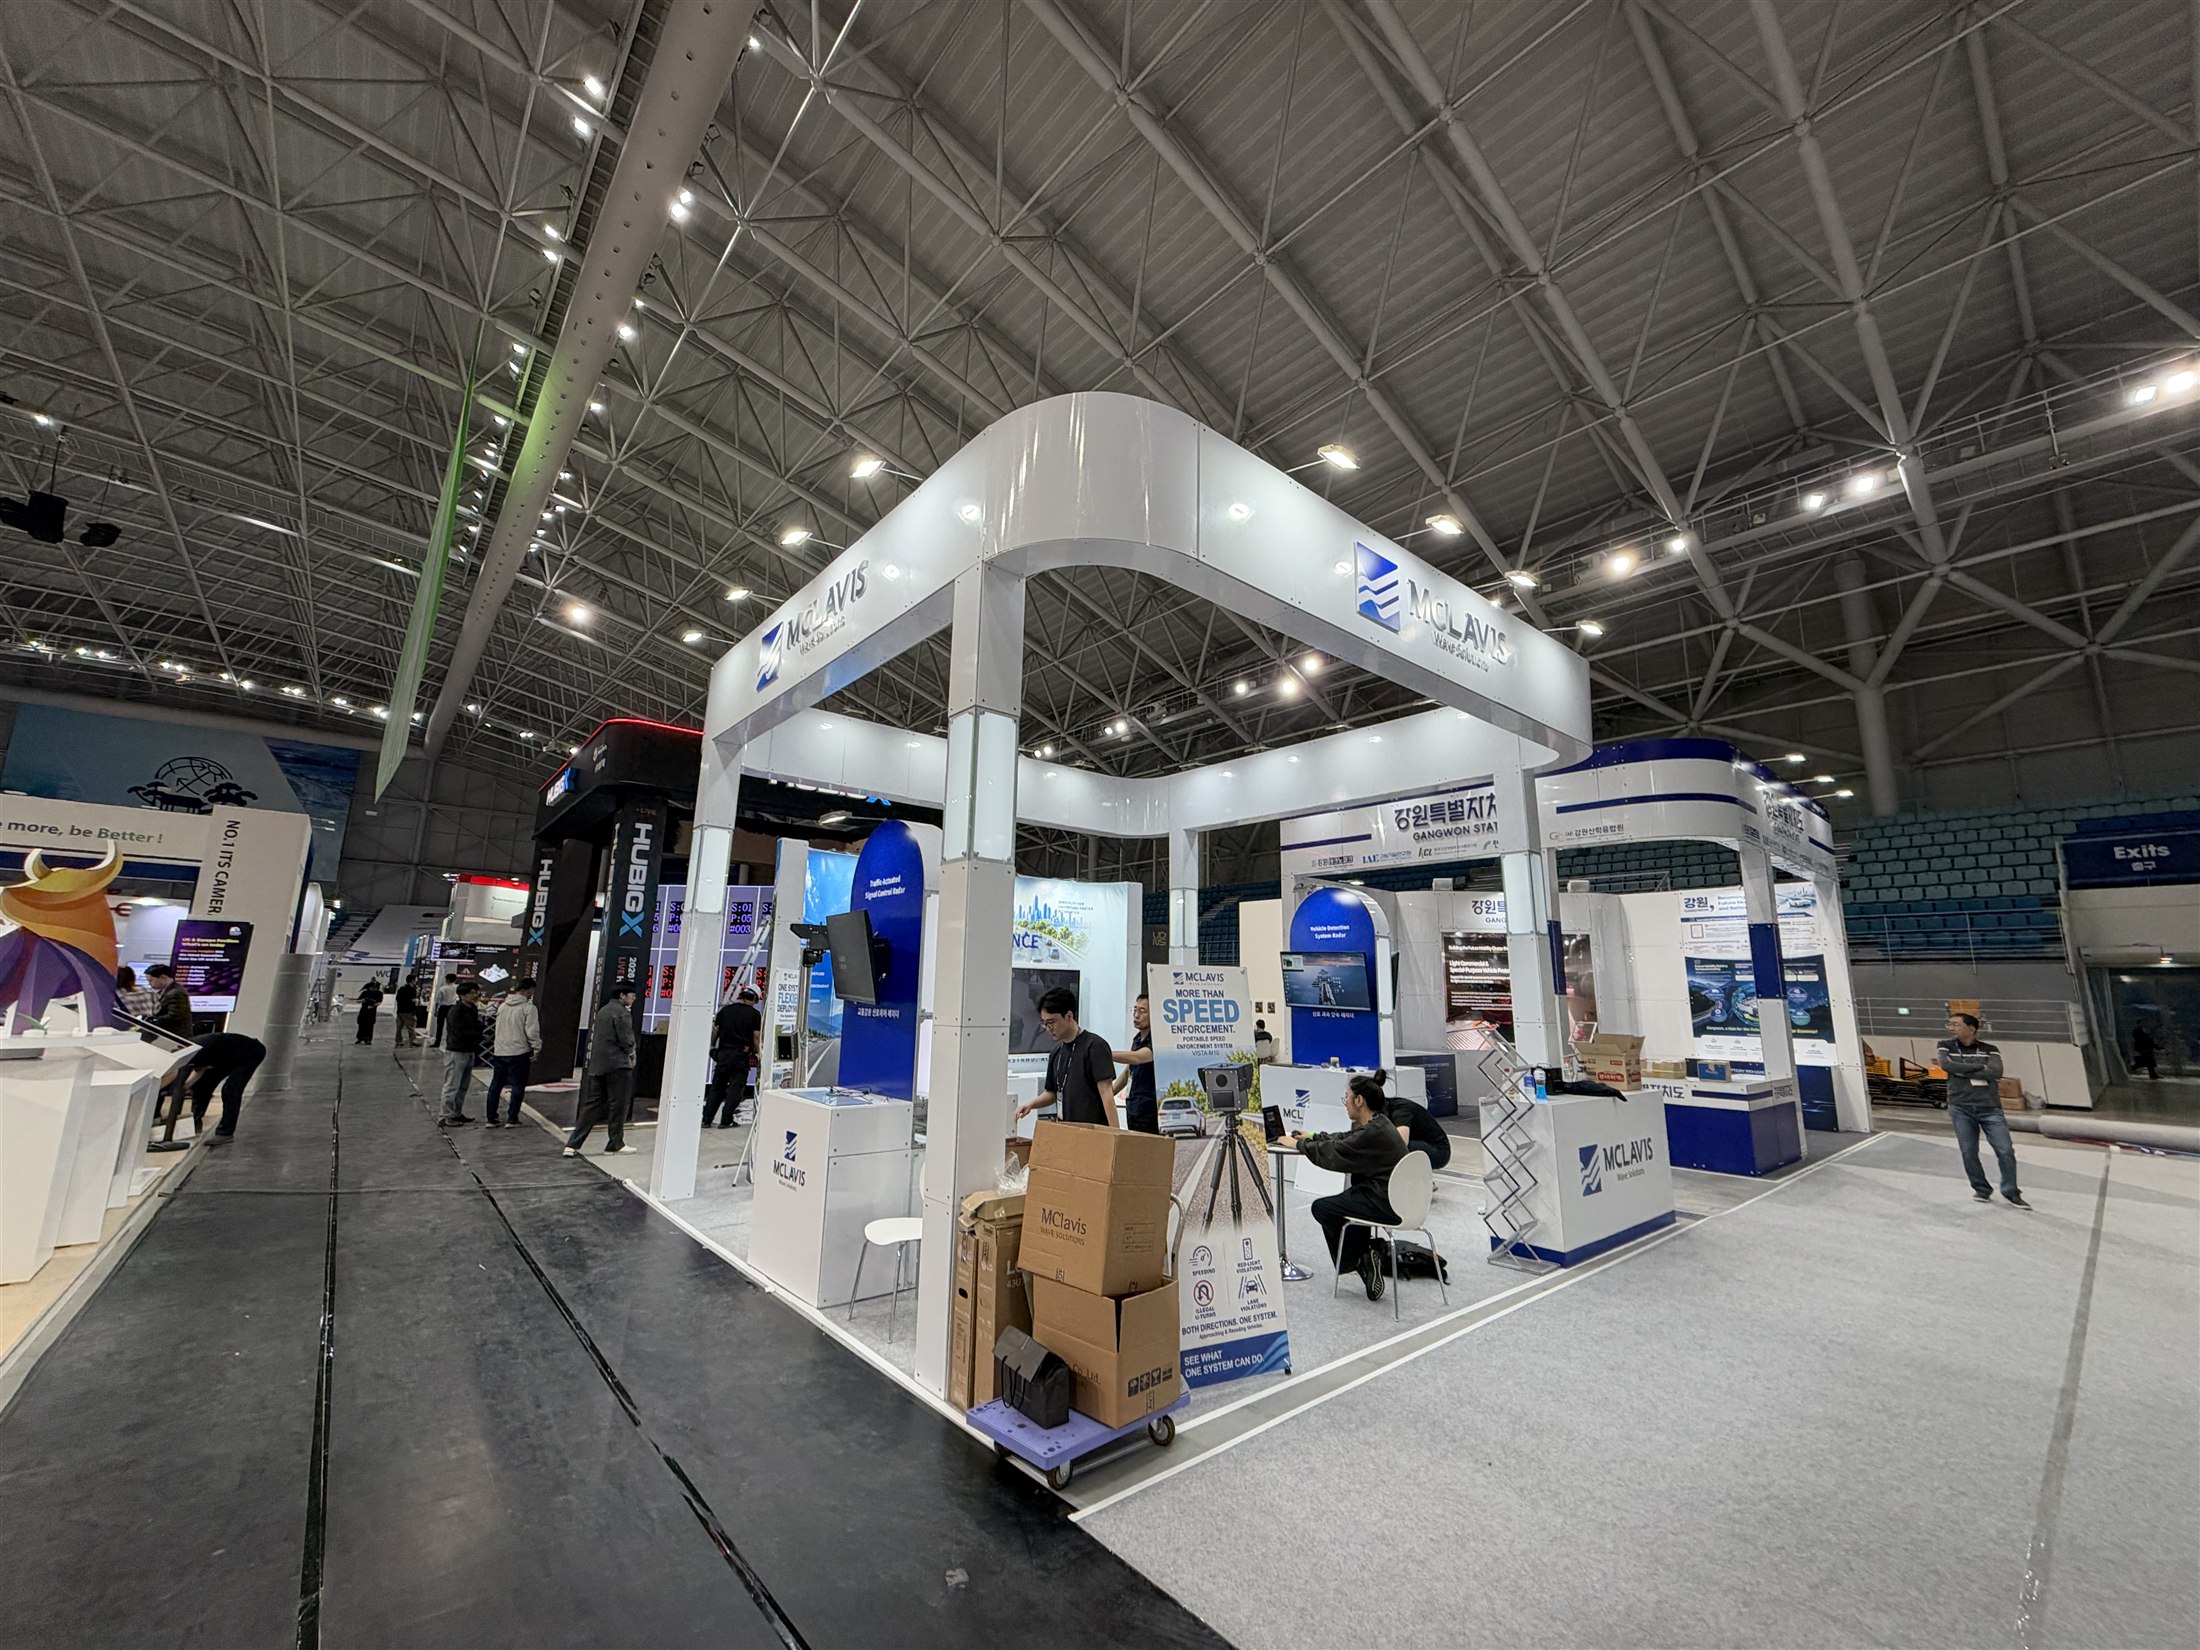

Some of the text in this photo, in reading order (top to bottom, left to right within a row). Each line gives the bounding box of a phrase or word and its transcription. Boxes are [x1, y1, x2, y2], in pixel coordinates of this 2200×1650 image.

[786, 559, 869, 651] MCLAVIS
[1407, 578, 1511, 666] MCLAVIS
[1432, 631, 1456, 656] Wave
[7, 821, 63, 837] more,
[69, 824, 93, 838] be
[97, 827, 155, 843] Better
[1413, 825, 1471, 841] GANGWON
[2113, 844, 2171, 860] Exits
[207, 820, 240, 915] NO.1 ITS CAMER
[619, 822, 653, 938] HUBIGX
[527, 858, 553, 947] HUBIGX
[731, 903, 753, 912] S:01
[730, 914, 752, 923] P:05
[729, 924, 751, 933] #003
[628, 956, 637, 978] 2026
[1185, 972, 1225, 983] MCLAVIS
[1175, 989, 1224, 998] MORE THAN
[1163, 998, 1240, 1024] SPEED
[1171, 1024, 1236, 1035] ENFORCEMENT.
[1603, 1137, 1654, 1172] MCLAVIS
[773, 1159, 806, 1187] MCLAVIS
[1041, 1207, 1088, 1236] MClavis
[1040, 1226, 1086, 1247] WAVE SOLUTIONS
[1192, 1268, 1216, 1277] SPEEDING
[1236, 1265, 1263, 1274] VIOLATIONS
[1237, 1260, 1261, 1269] RED-LIGHT
[1195, 1306, 1215, 1314] ILLEGAL
[1240, 1303, 1267, 1312] VIOLATIONS
[1246, 1298, 1260, 1306] LANE
[1182, 1311, 1278, 1336] BOTH DIRECTIONS. ONE SYSTEM.
[1184, 1350, 1223, 1367] SEE WHAT
[1185, 1366, 1202, 1378] ONE
[1203, 1360, 1235, 1375] SYSTEM
[1234, 1356, 1252, 1368] CAN
